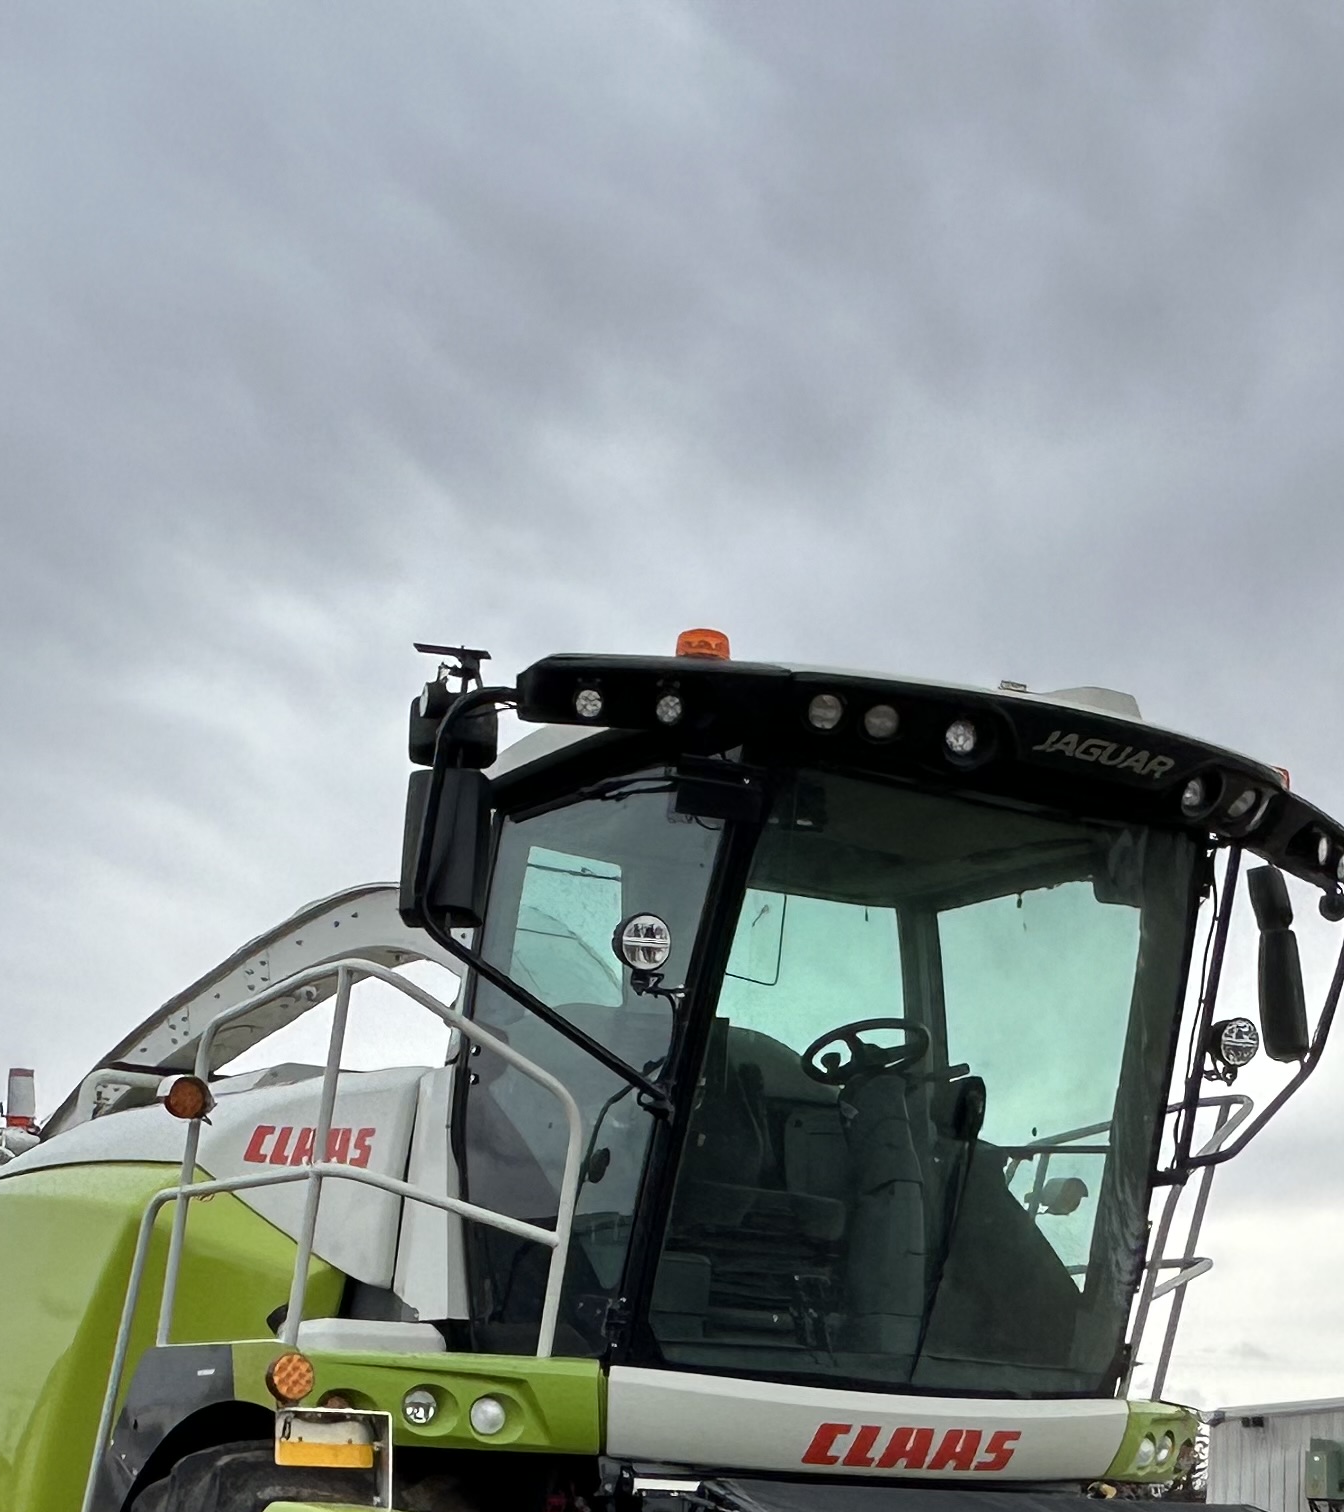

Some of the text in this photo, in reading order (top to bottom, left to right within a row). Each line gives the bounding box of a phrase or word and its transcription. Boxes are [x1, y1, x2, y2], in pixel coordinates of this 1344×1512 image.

[1032, 731, 1175, 779] JAGUAR
[243, 1125, 376, 1168] CLAAS
[801, 1422, 1022, 1471] CLAAS
